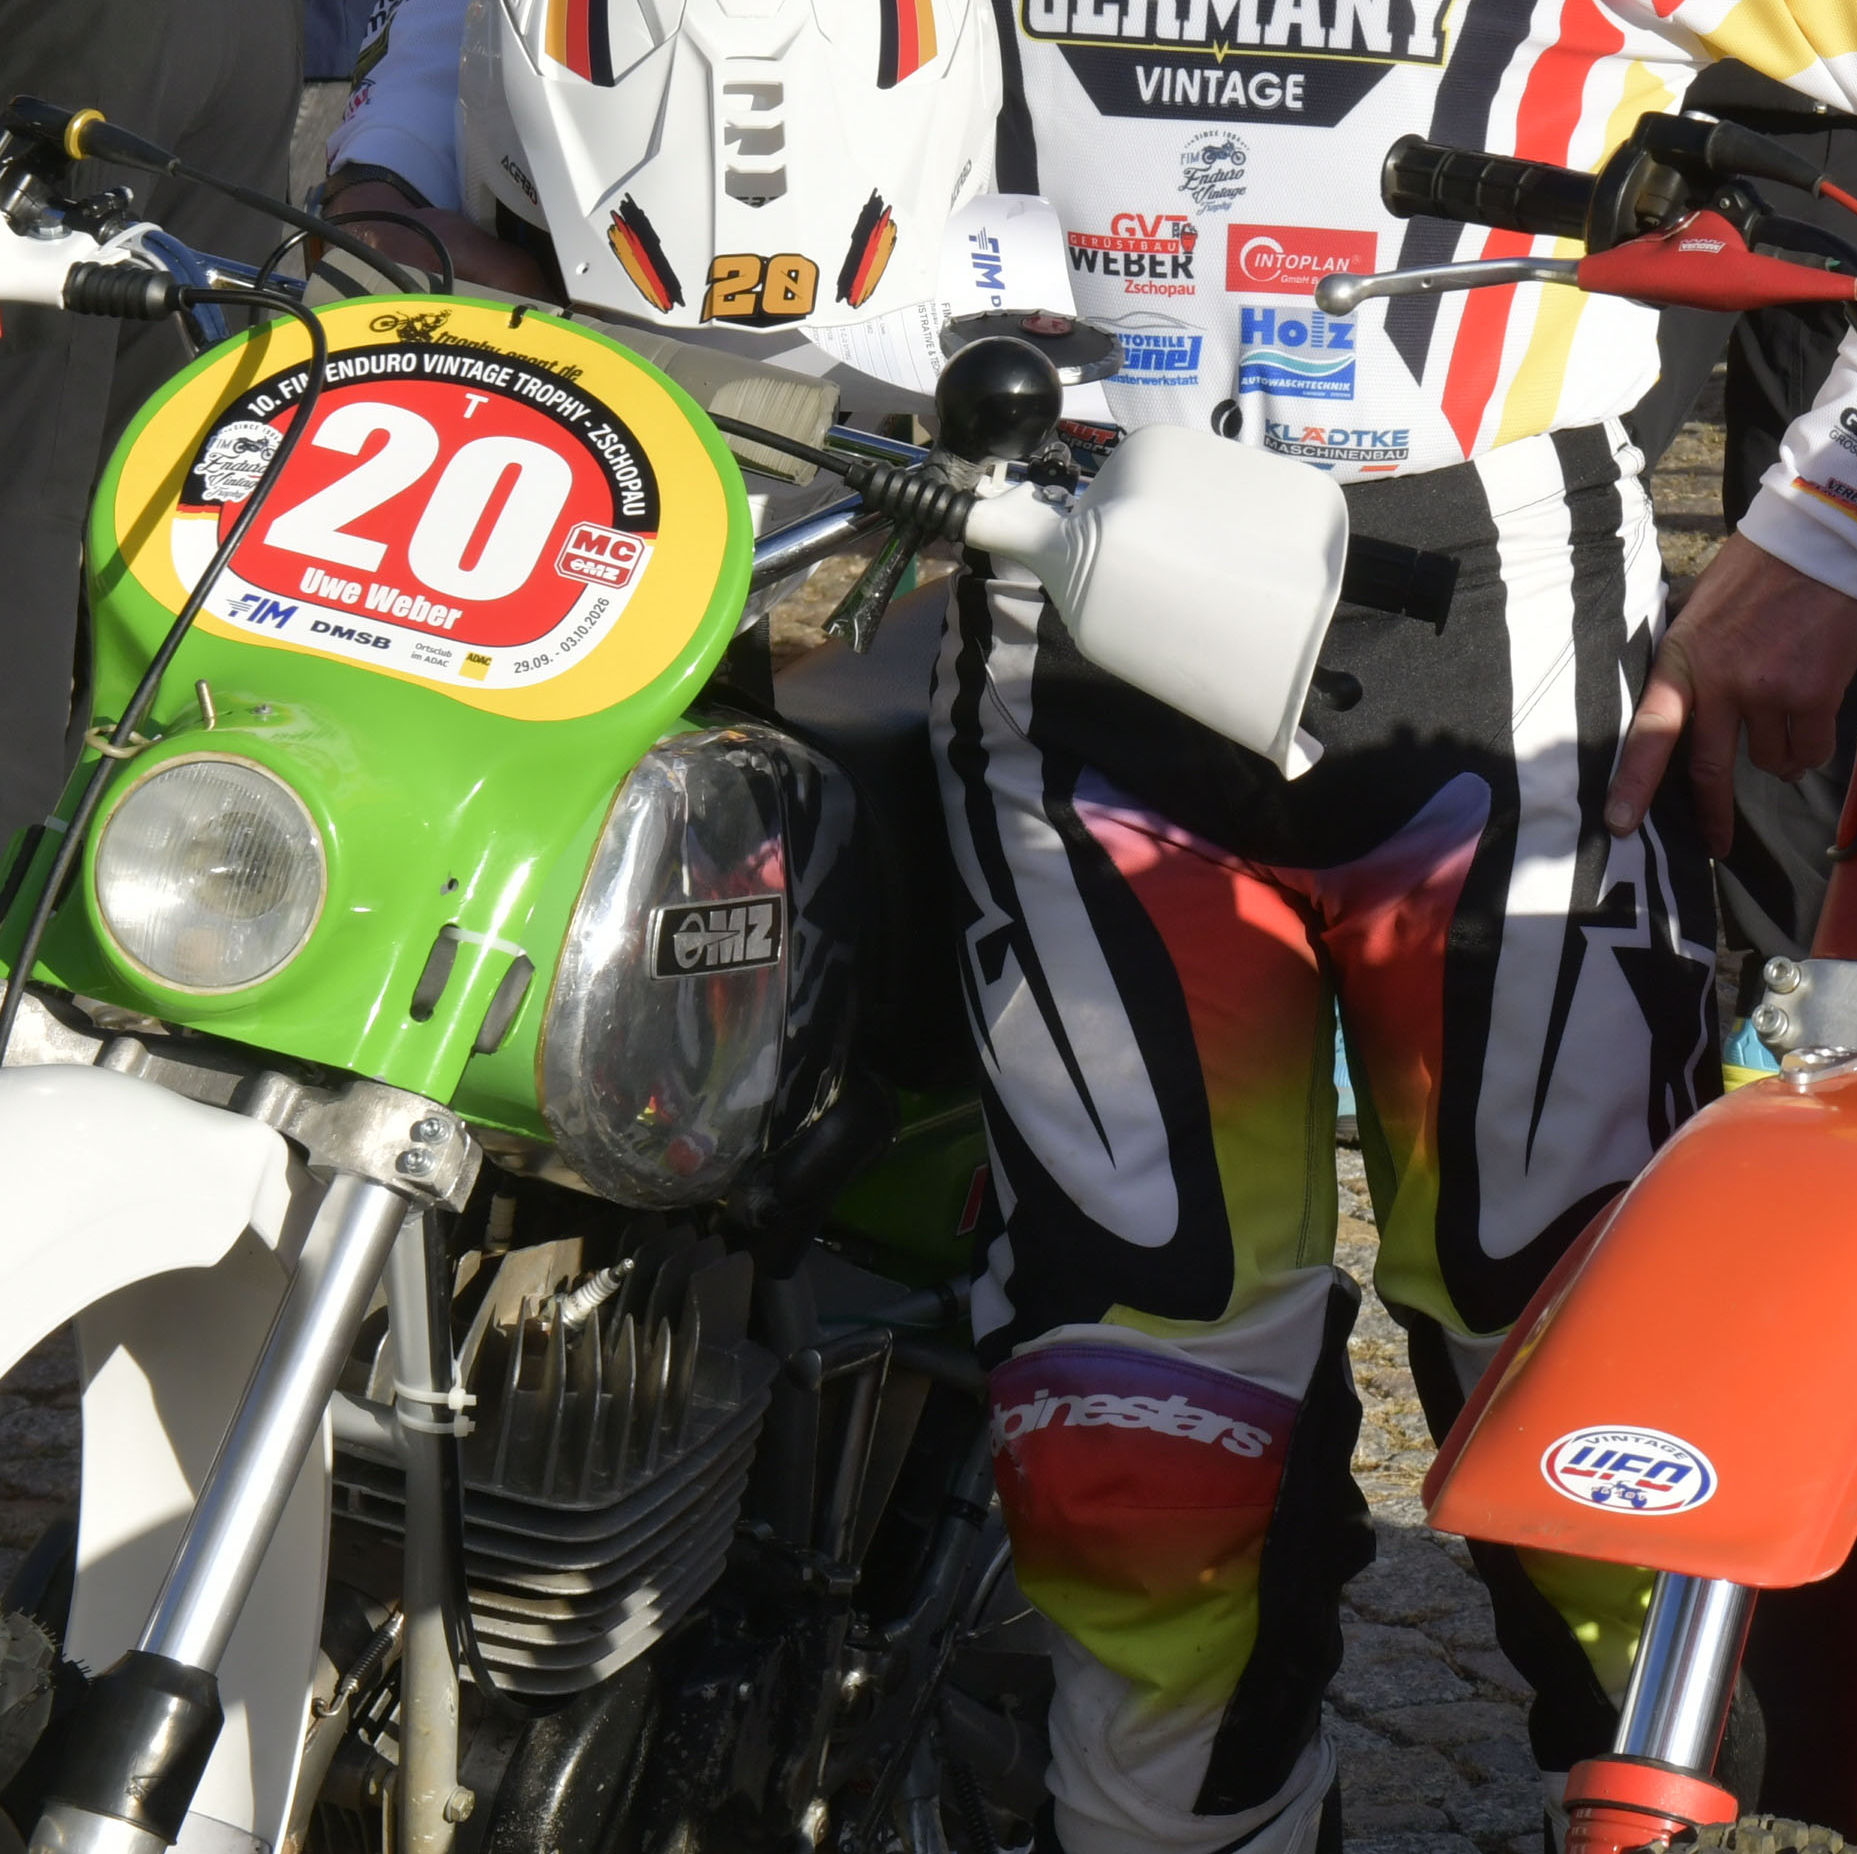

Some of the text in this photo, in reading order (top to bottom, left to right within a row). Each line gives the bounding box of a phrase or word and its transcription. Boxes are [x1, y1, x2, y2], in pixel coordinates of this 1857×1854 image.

[1135, 64, 1306, 112] VINTAGE
[1178, 164, 1246, 193] Enduro
[968, 226, 1006, 291] FIM
[1069, 233, 1178, 253] GERÜSTBAU
[1068, 247, 1195, 280] WEBER
[1254, 252, 1350, 272] INTOPLAN
[1124, 279, 1196, 298] Zschopau
[917, 303, 936, 351] ISTRATIVE
[1241, 307, 1354, 349] Holz
[1240, 376, 1351, 393] AUTOWASCHTECHNIK
[464, 393, 490, 420] T
[324, 353, 418, 384] ENDURO
[422, 353, 514, 389] VINTAGE
[512, 369, 587, 424] TROPHY
[586, 423, 646, 517] ZSCHOPAU
[1265, 437, 1409, 461] MASCHINENBAU
[263, 401, 573, 602] 20
[571, 530, 640, 563] MC
[225, 593, 300, 631] FIM
[299, 565, 464, 631] Uwe Weber
[310, 619, 393, 652] DMSB
[558, 596, 612, 655] 03.10.2026
[414, 640, 453, 660] Ortsclub
[424, 652, 451, 669] ADAC
[463, 651, 493, 668] ADAC
[990, 1389, 1272, 1458] pinestars
[1585, 1434, 1688, 1461] VINTAGE
[1560, 1445, 1694, 1493] UFO
